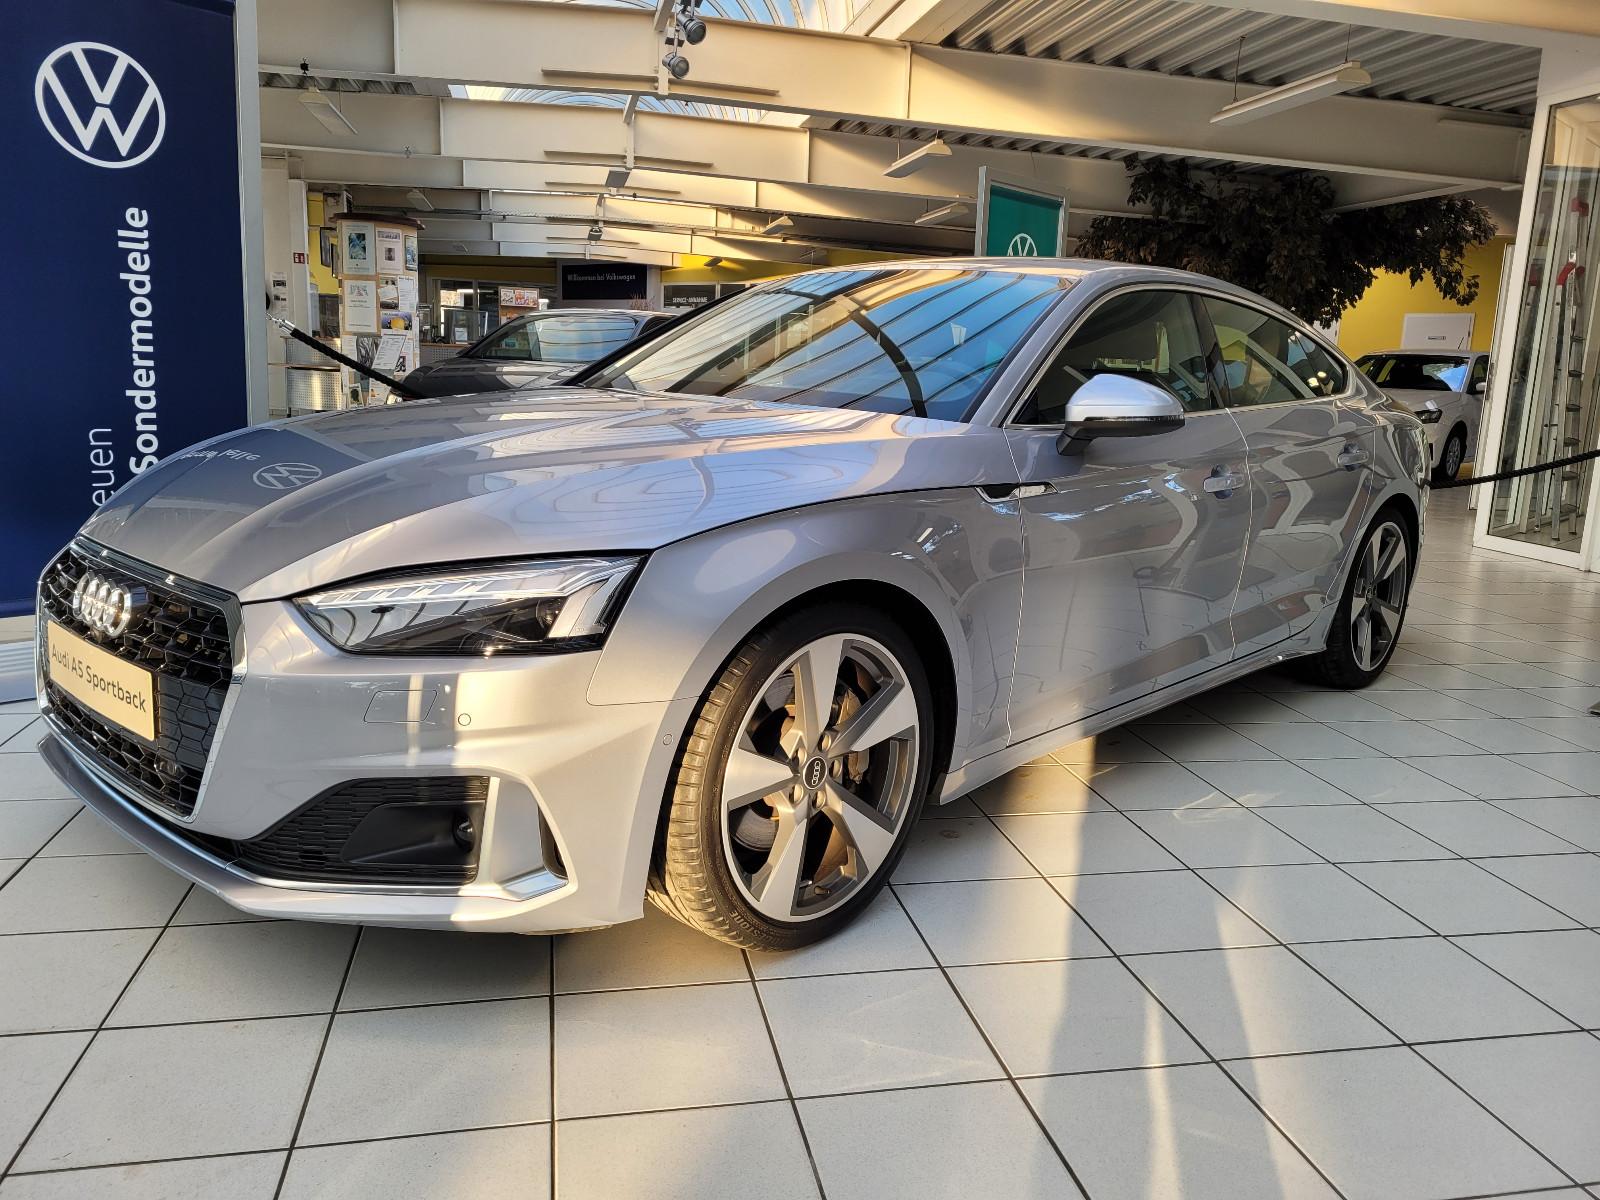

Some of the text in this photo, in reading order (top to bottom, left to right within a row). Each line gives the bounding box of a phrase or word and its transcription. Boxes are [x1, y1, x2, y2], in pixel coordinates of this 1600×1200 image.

[117, 206, 160, 475] Sondermodelle
[51, 644, 147, 713] Audi A5 Sportback
